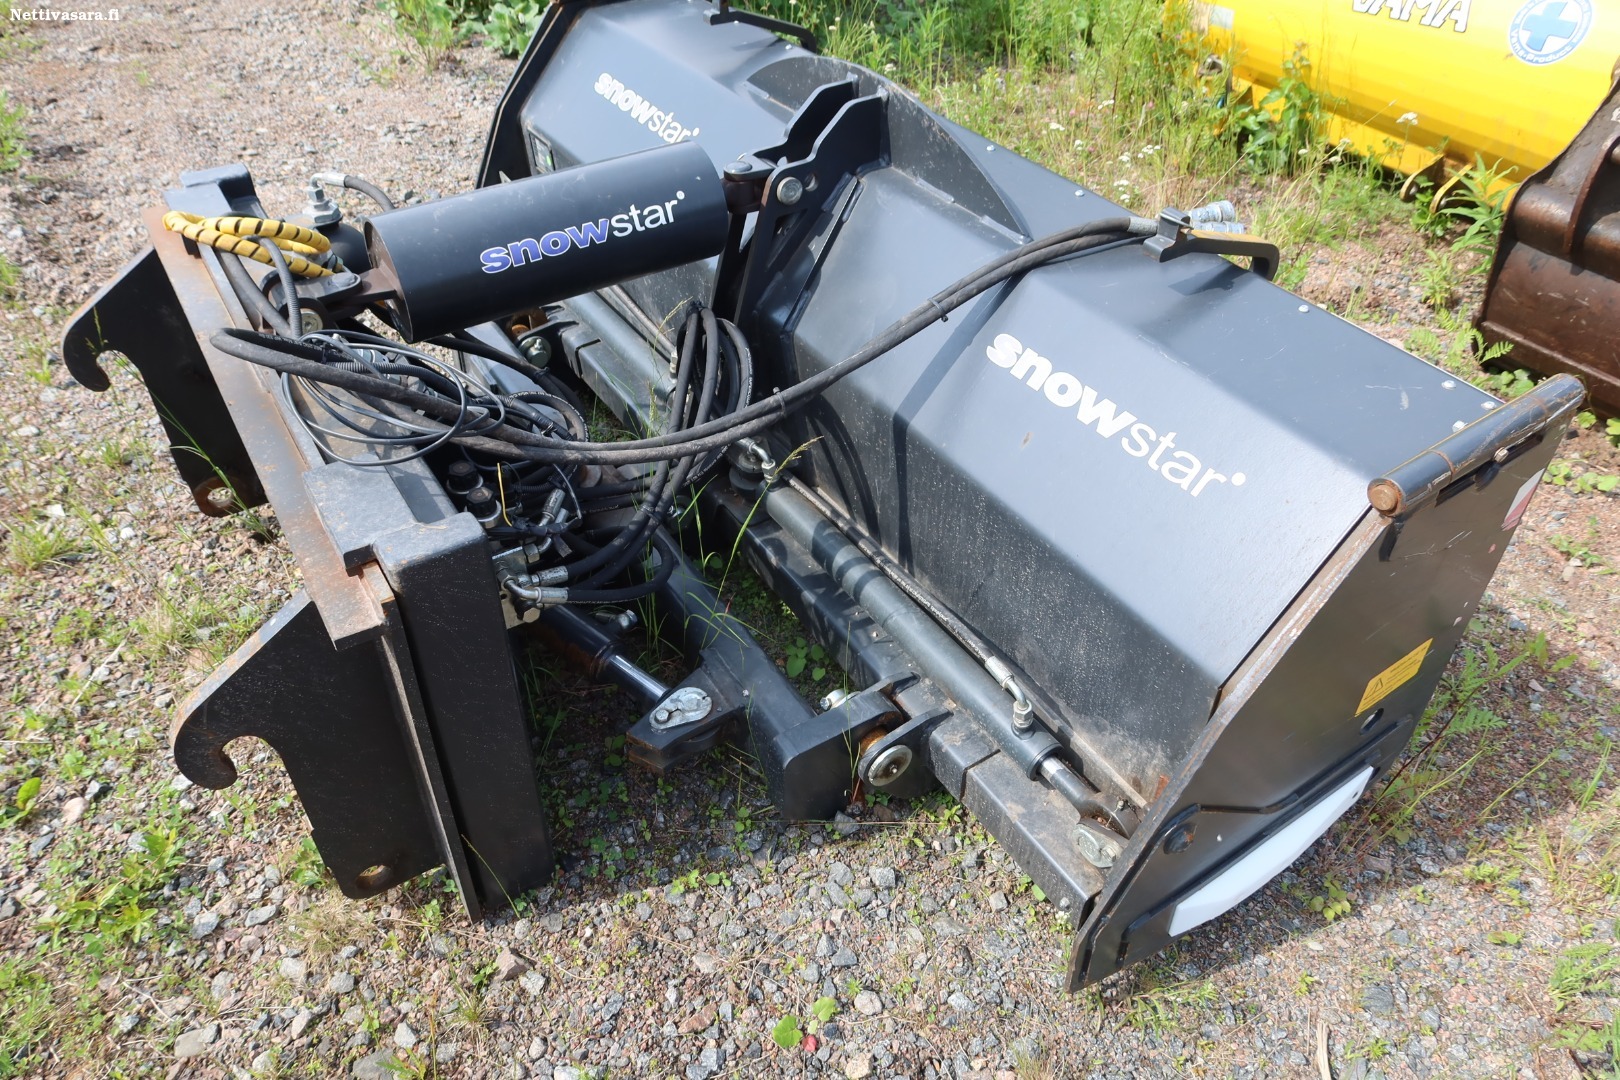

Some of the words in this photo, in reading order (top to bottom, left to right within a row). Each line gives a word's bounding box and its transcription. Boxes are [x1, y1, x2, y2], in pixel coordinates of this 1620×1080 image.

[594, 73, 699, 144] snowstar
[480, 190, 685, 274] snowstar
[986, 333, 1246, 498] snowstar
